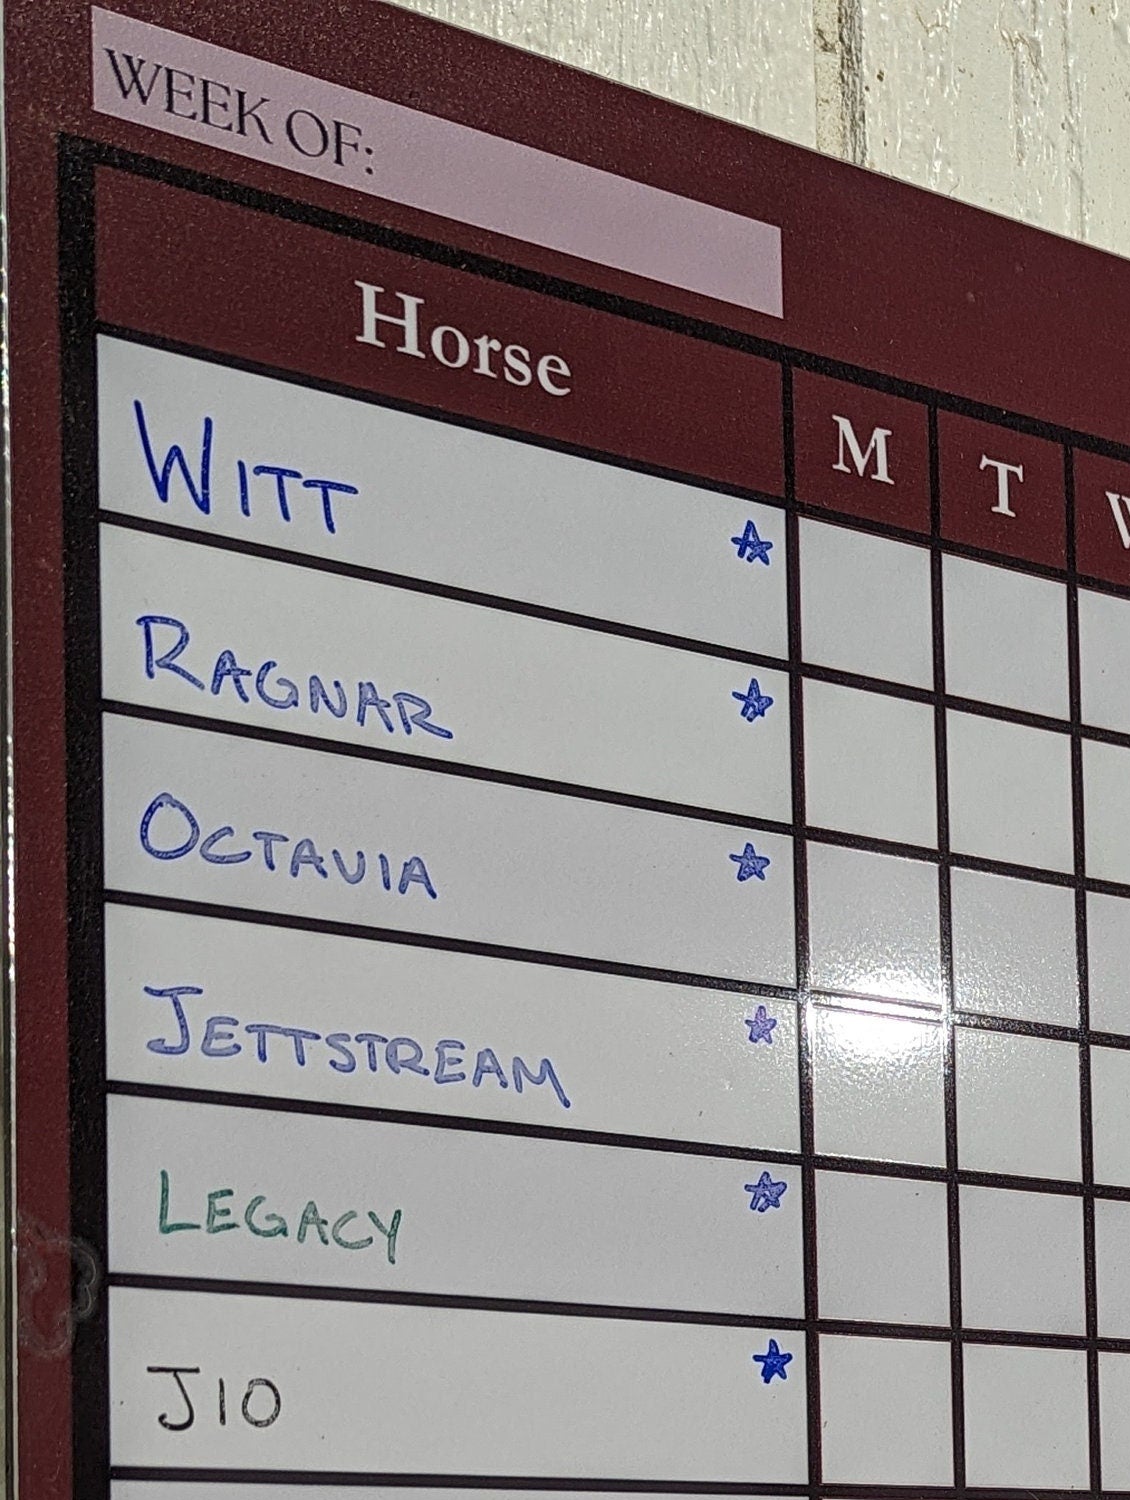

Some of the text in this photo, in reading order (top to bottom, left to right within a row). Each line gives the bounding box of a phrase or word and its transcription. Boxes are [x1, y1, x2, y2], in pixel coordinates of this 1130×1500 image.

[104, 46, 375, 175] WEEK OF:
[354, 280, 572, 396] Horse
[133, 400, 359, 534] WITT
[831, 414, 895, 486] M
[978, 453, 1024, 518] T
[135, 614, 454, 741] RAGNAR
[139, 793, 438, 899] OCTAVIA
[143, 985, 571, 1108] JETTSTREAM
[158, 1169, 402, 1265] LEGACY
